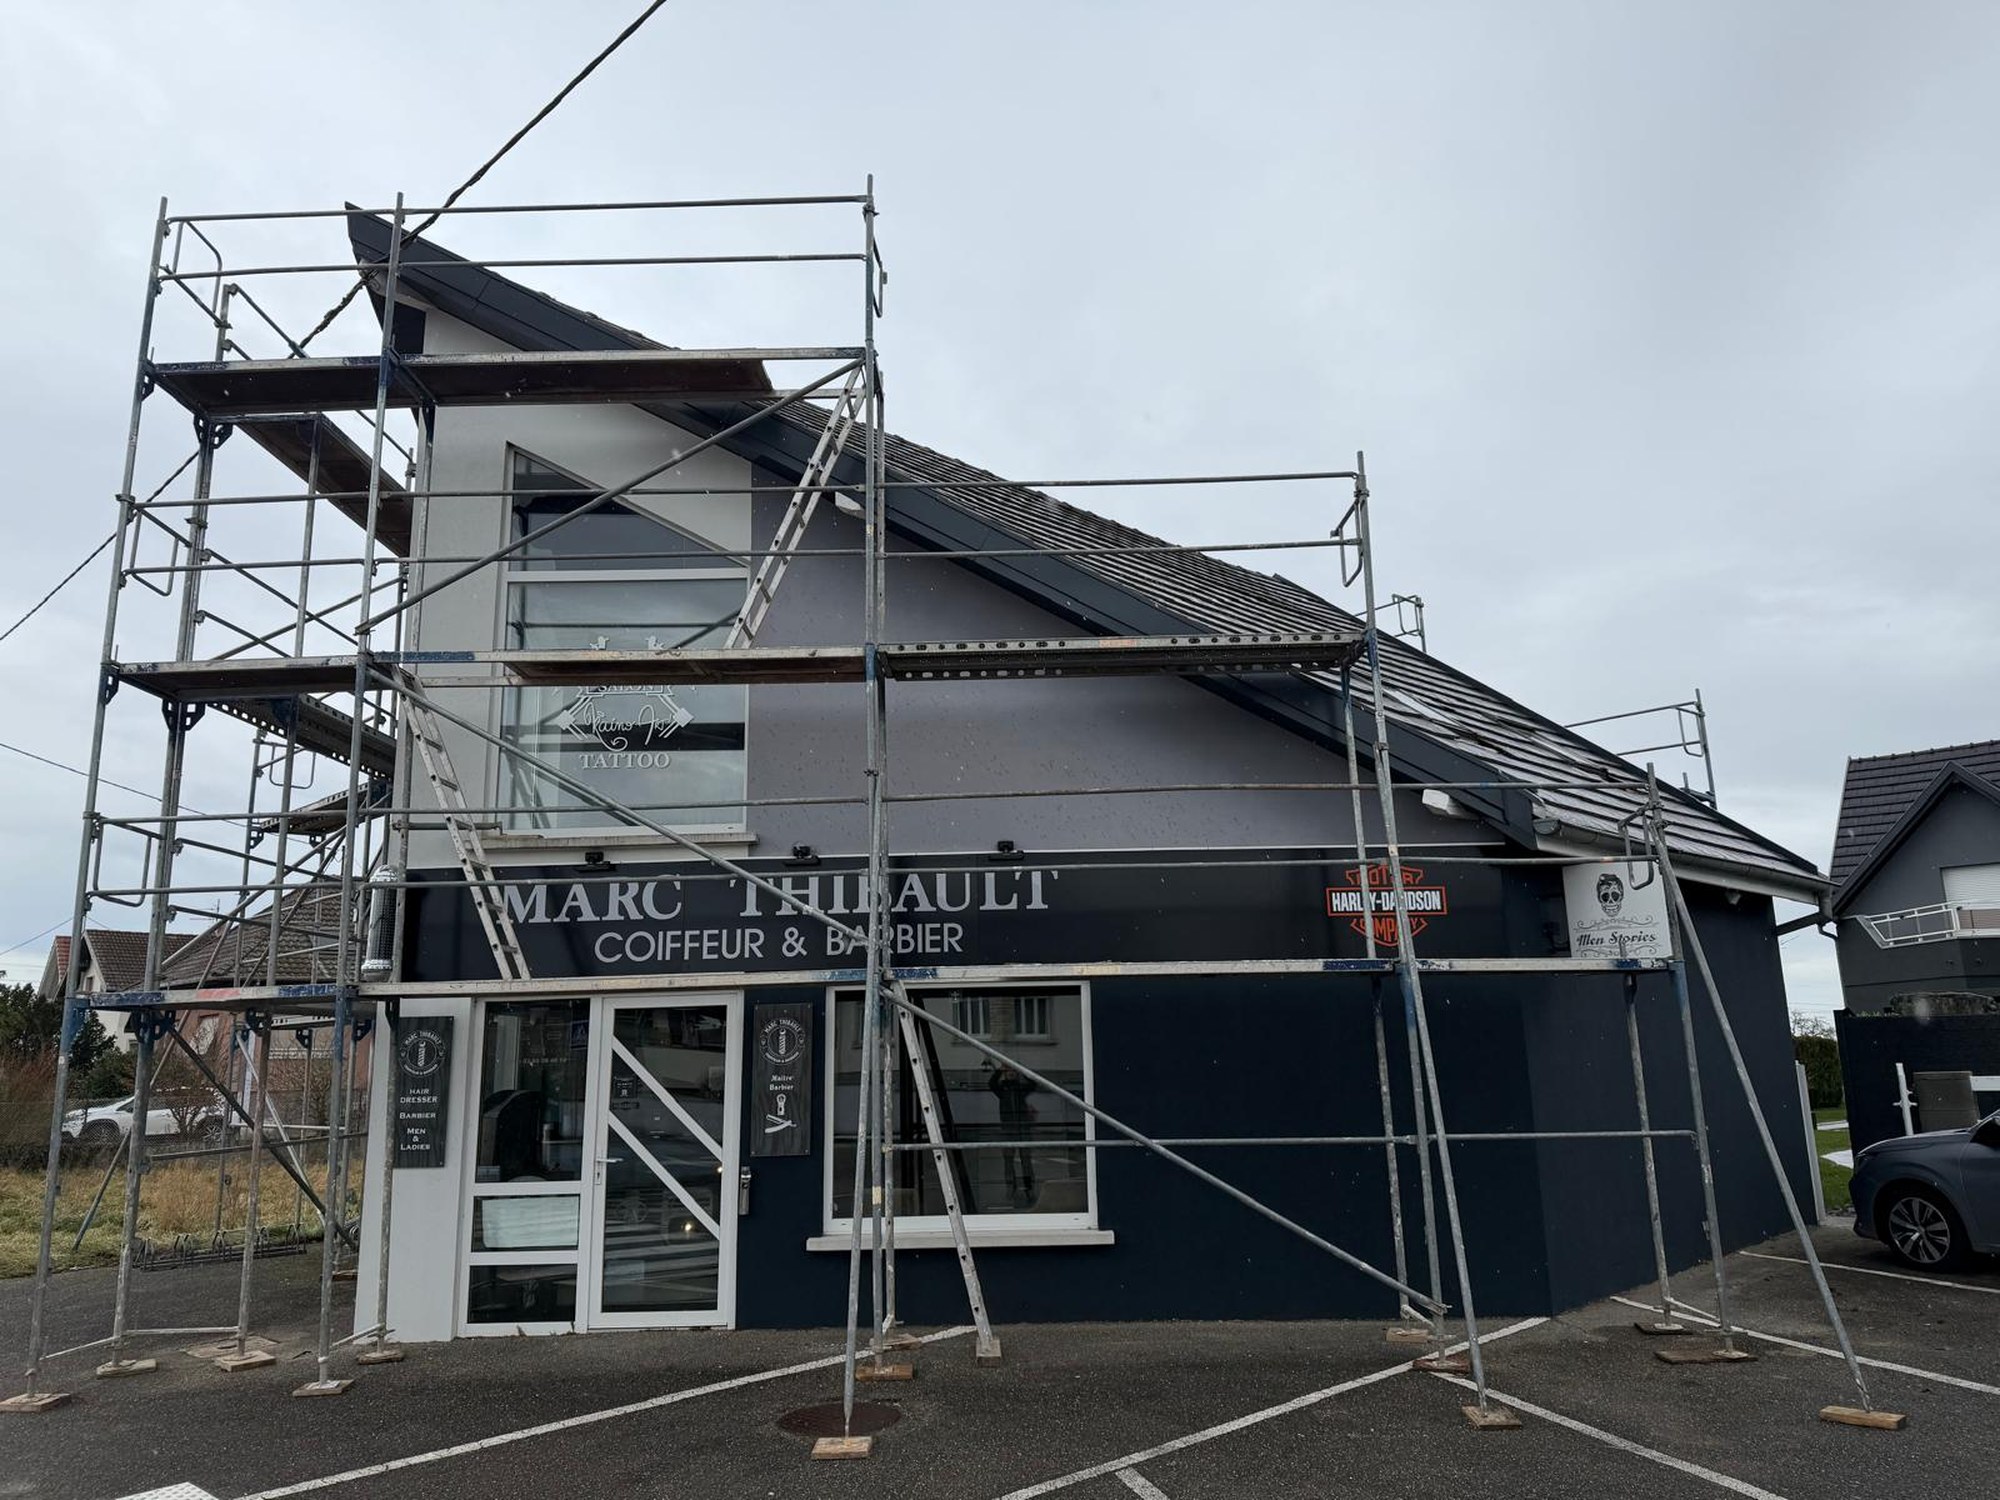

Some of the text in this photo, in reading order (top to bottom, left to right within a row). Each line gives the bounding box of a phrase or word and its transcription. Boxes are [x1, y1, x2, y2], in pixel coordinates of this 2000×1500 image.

[580, 752, 670, 769] TATTOO
[497, 874, 682, 924] MARC
[594, 928, 765, 963] COIFFEUR
[782, 926, 808, 957] &
[1575, 930, 1657, 947] Men Stories
[400, 1143, 431, 1151] LADIES
